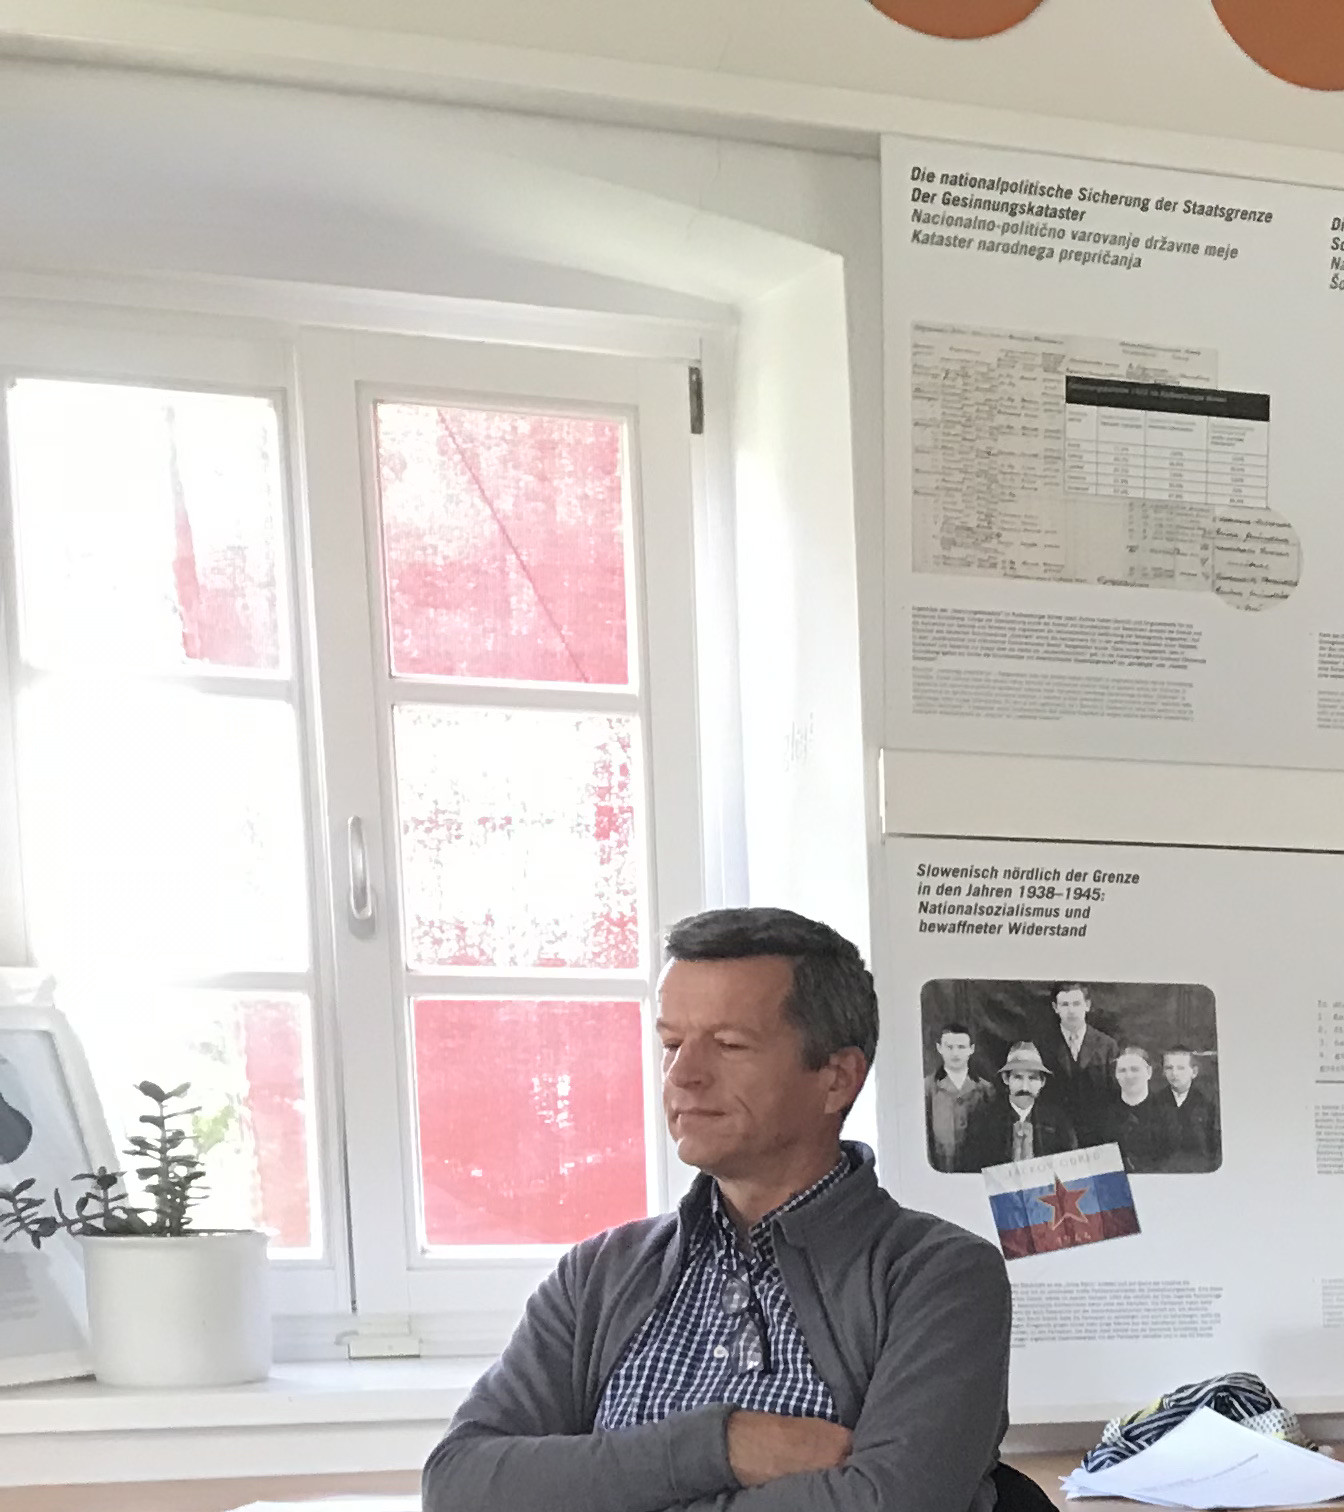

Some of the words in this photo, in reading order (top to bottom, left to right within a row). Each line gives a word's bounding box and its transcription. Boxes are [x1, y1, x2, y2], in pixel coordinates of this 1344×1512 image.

[910, 166, 936, 185] Die
[940, 171, 1074, 201] nationalpolitische
[1078, 187, 1150, 214] Sicherung
[1155, 198, 1179, 213] der
[1182, 200, 1273, 224] Staatsgrenze
[911, 188, 937, 206] Der
[941, 191, 1087, 222] Gesinnungskataster
[911, 209, 1066, 240] Nacionalno-politično
[1070, 229, 1141, 250] varovanje
[1144, 236, 1201, 256] državne
[1204, 243, 1240, 261] meje
[911, 229, 973, 251] Kataster
[977, 237, 1055, 260] narodnega
[1059, 247, 1142, 269] prepričanja
[916, 863, 999, 880] Slowenisch
[1002, 866, 1062, 882] nördlich
[1065, 869, 1089, 883] der
[1092, 870, 1141, 884] Grenze
[917, 881, 931, 896] in
[935, 883, 962, 897] den
[965, 884, 1013, 898] Jahren
[918, 901, 1061, 919] Nationalsozialismus
[1064, 906, 1091, 919] und
[918, 919, 1004, 935] bewaffneter
[1007, 922, 1088, 937] Widerstand
